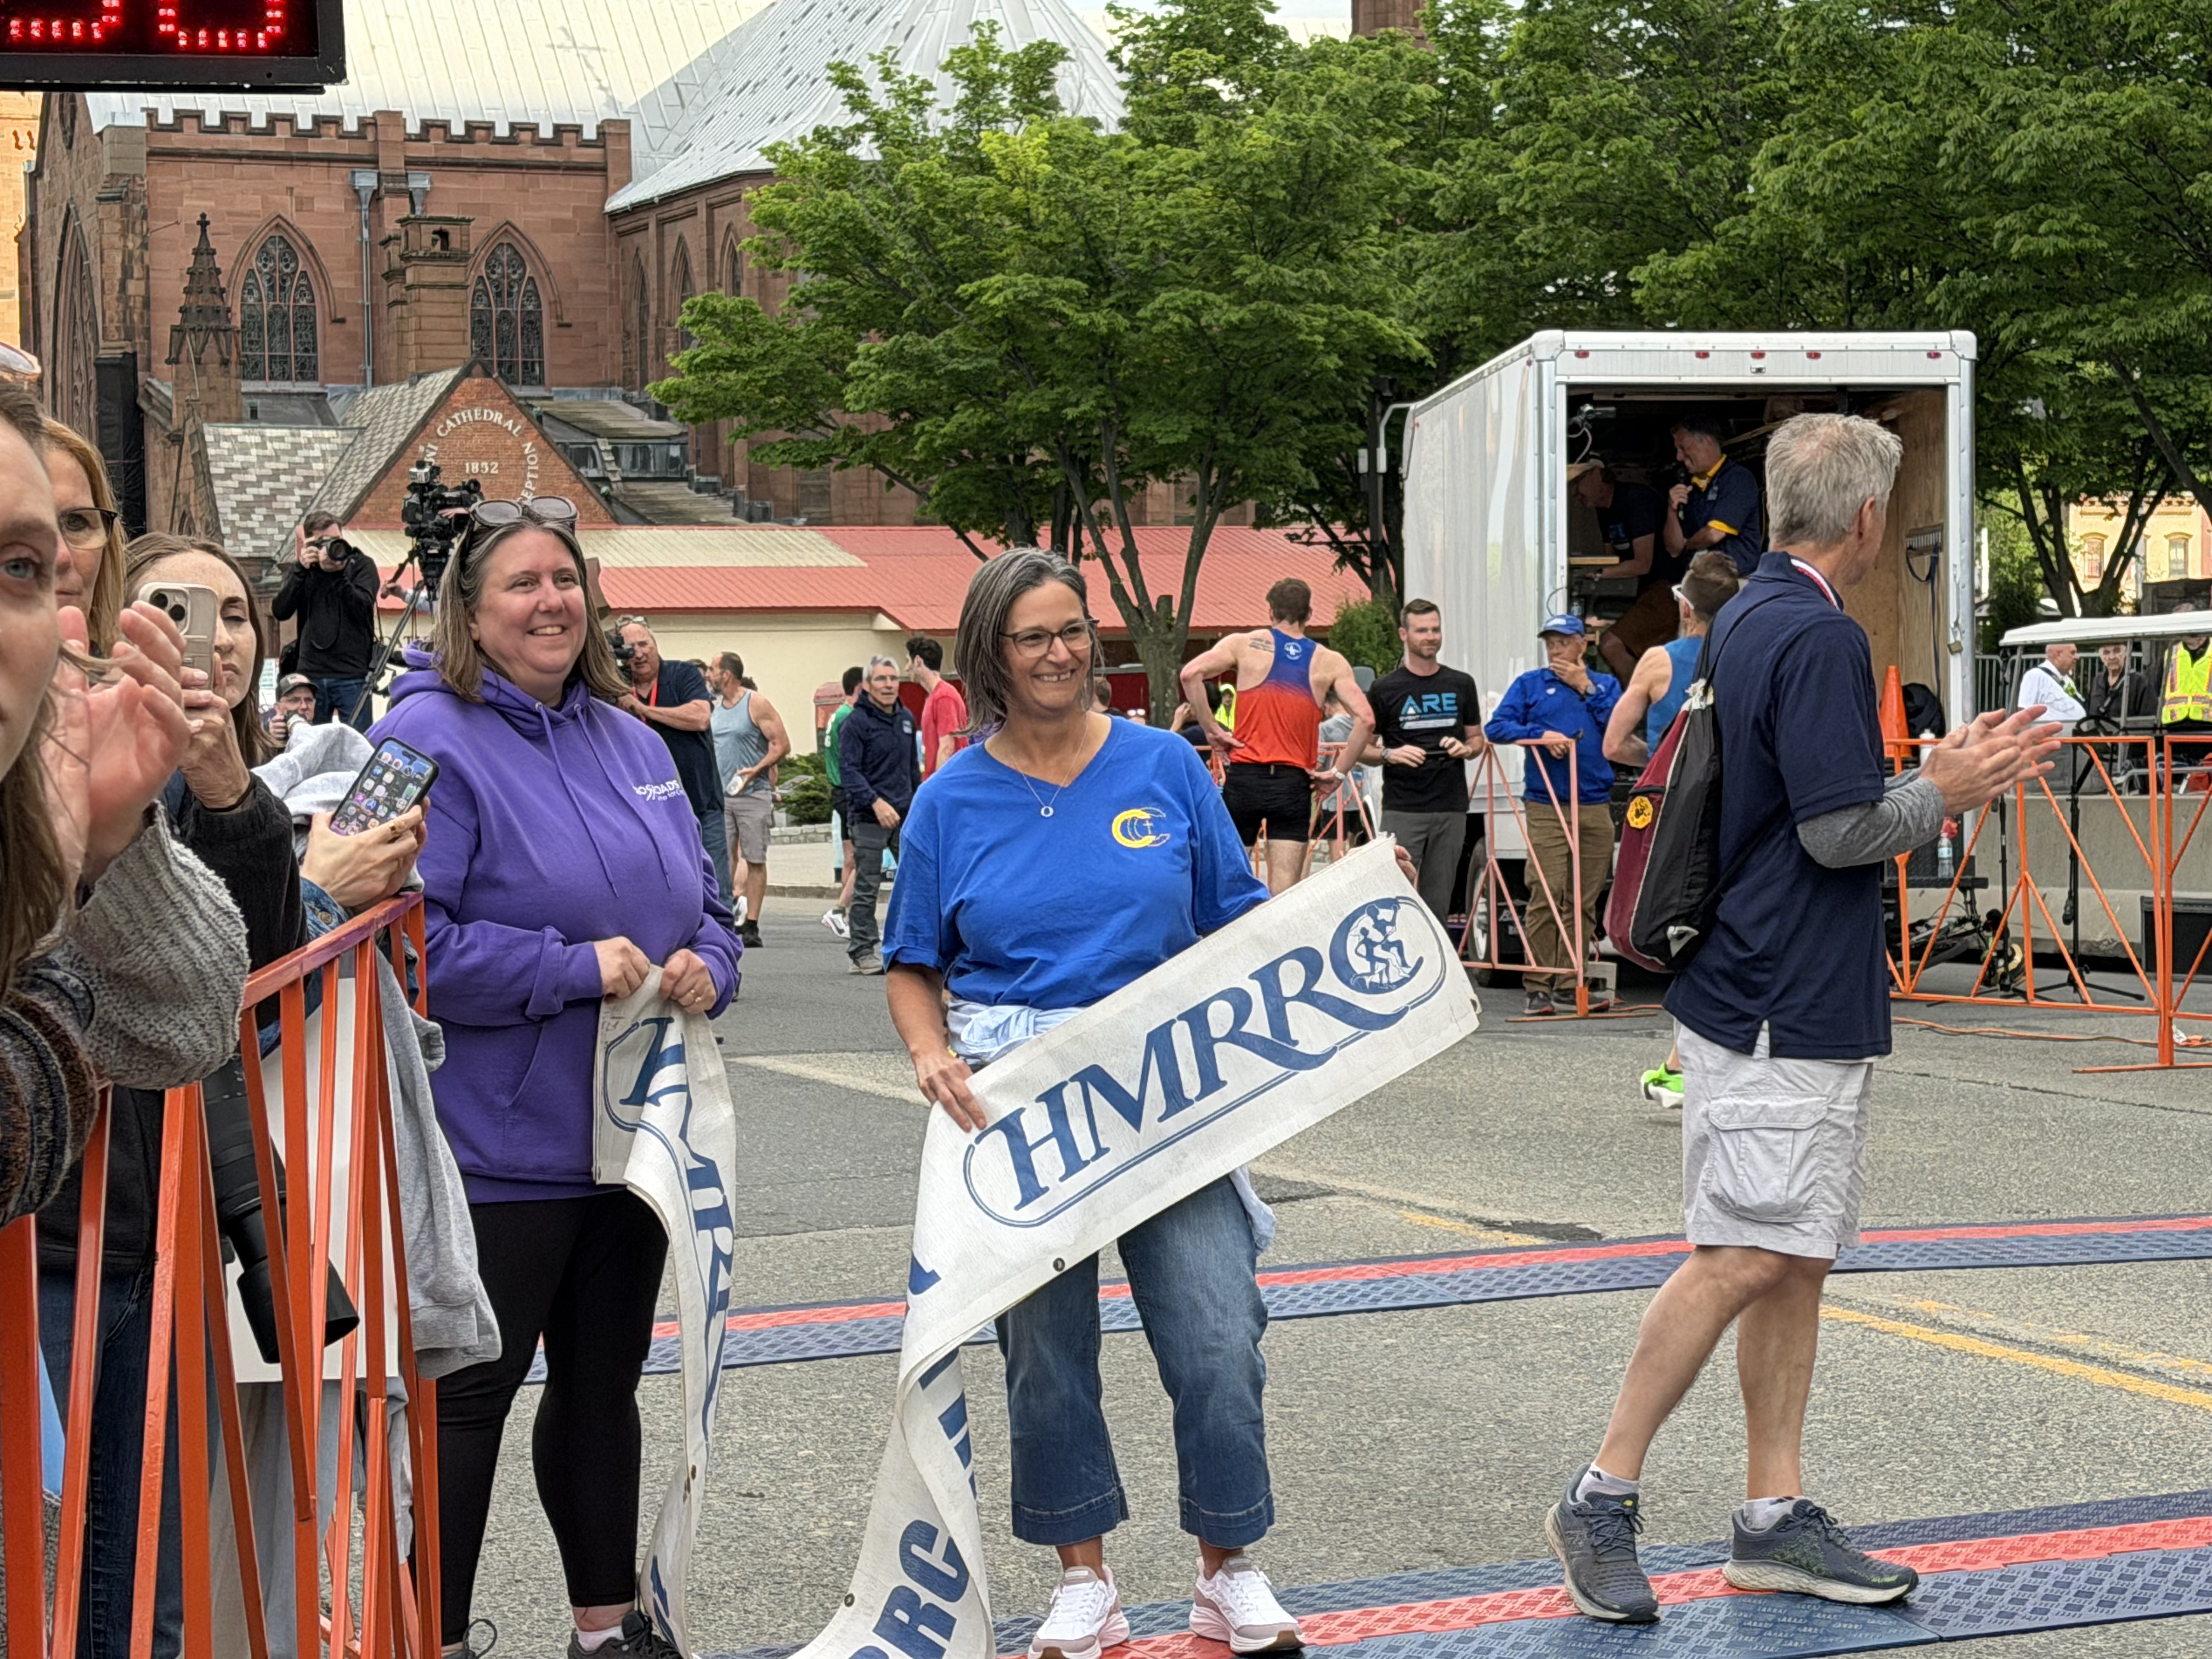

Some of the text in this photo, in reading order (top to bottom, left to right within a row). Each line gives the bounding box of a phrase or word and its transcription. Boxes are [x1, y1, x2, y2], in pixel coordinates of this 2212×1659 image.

[437, 408, 522, 438] CATHEDRAL
[465, 461, 499, 475] 1852
[1400, 693, 1458, 715] ARE
[974, 896, 1425, 1212] HMRRC
